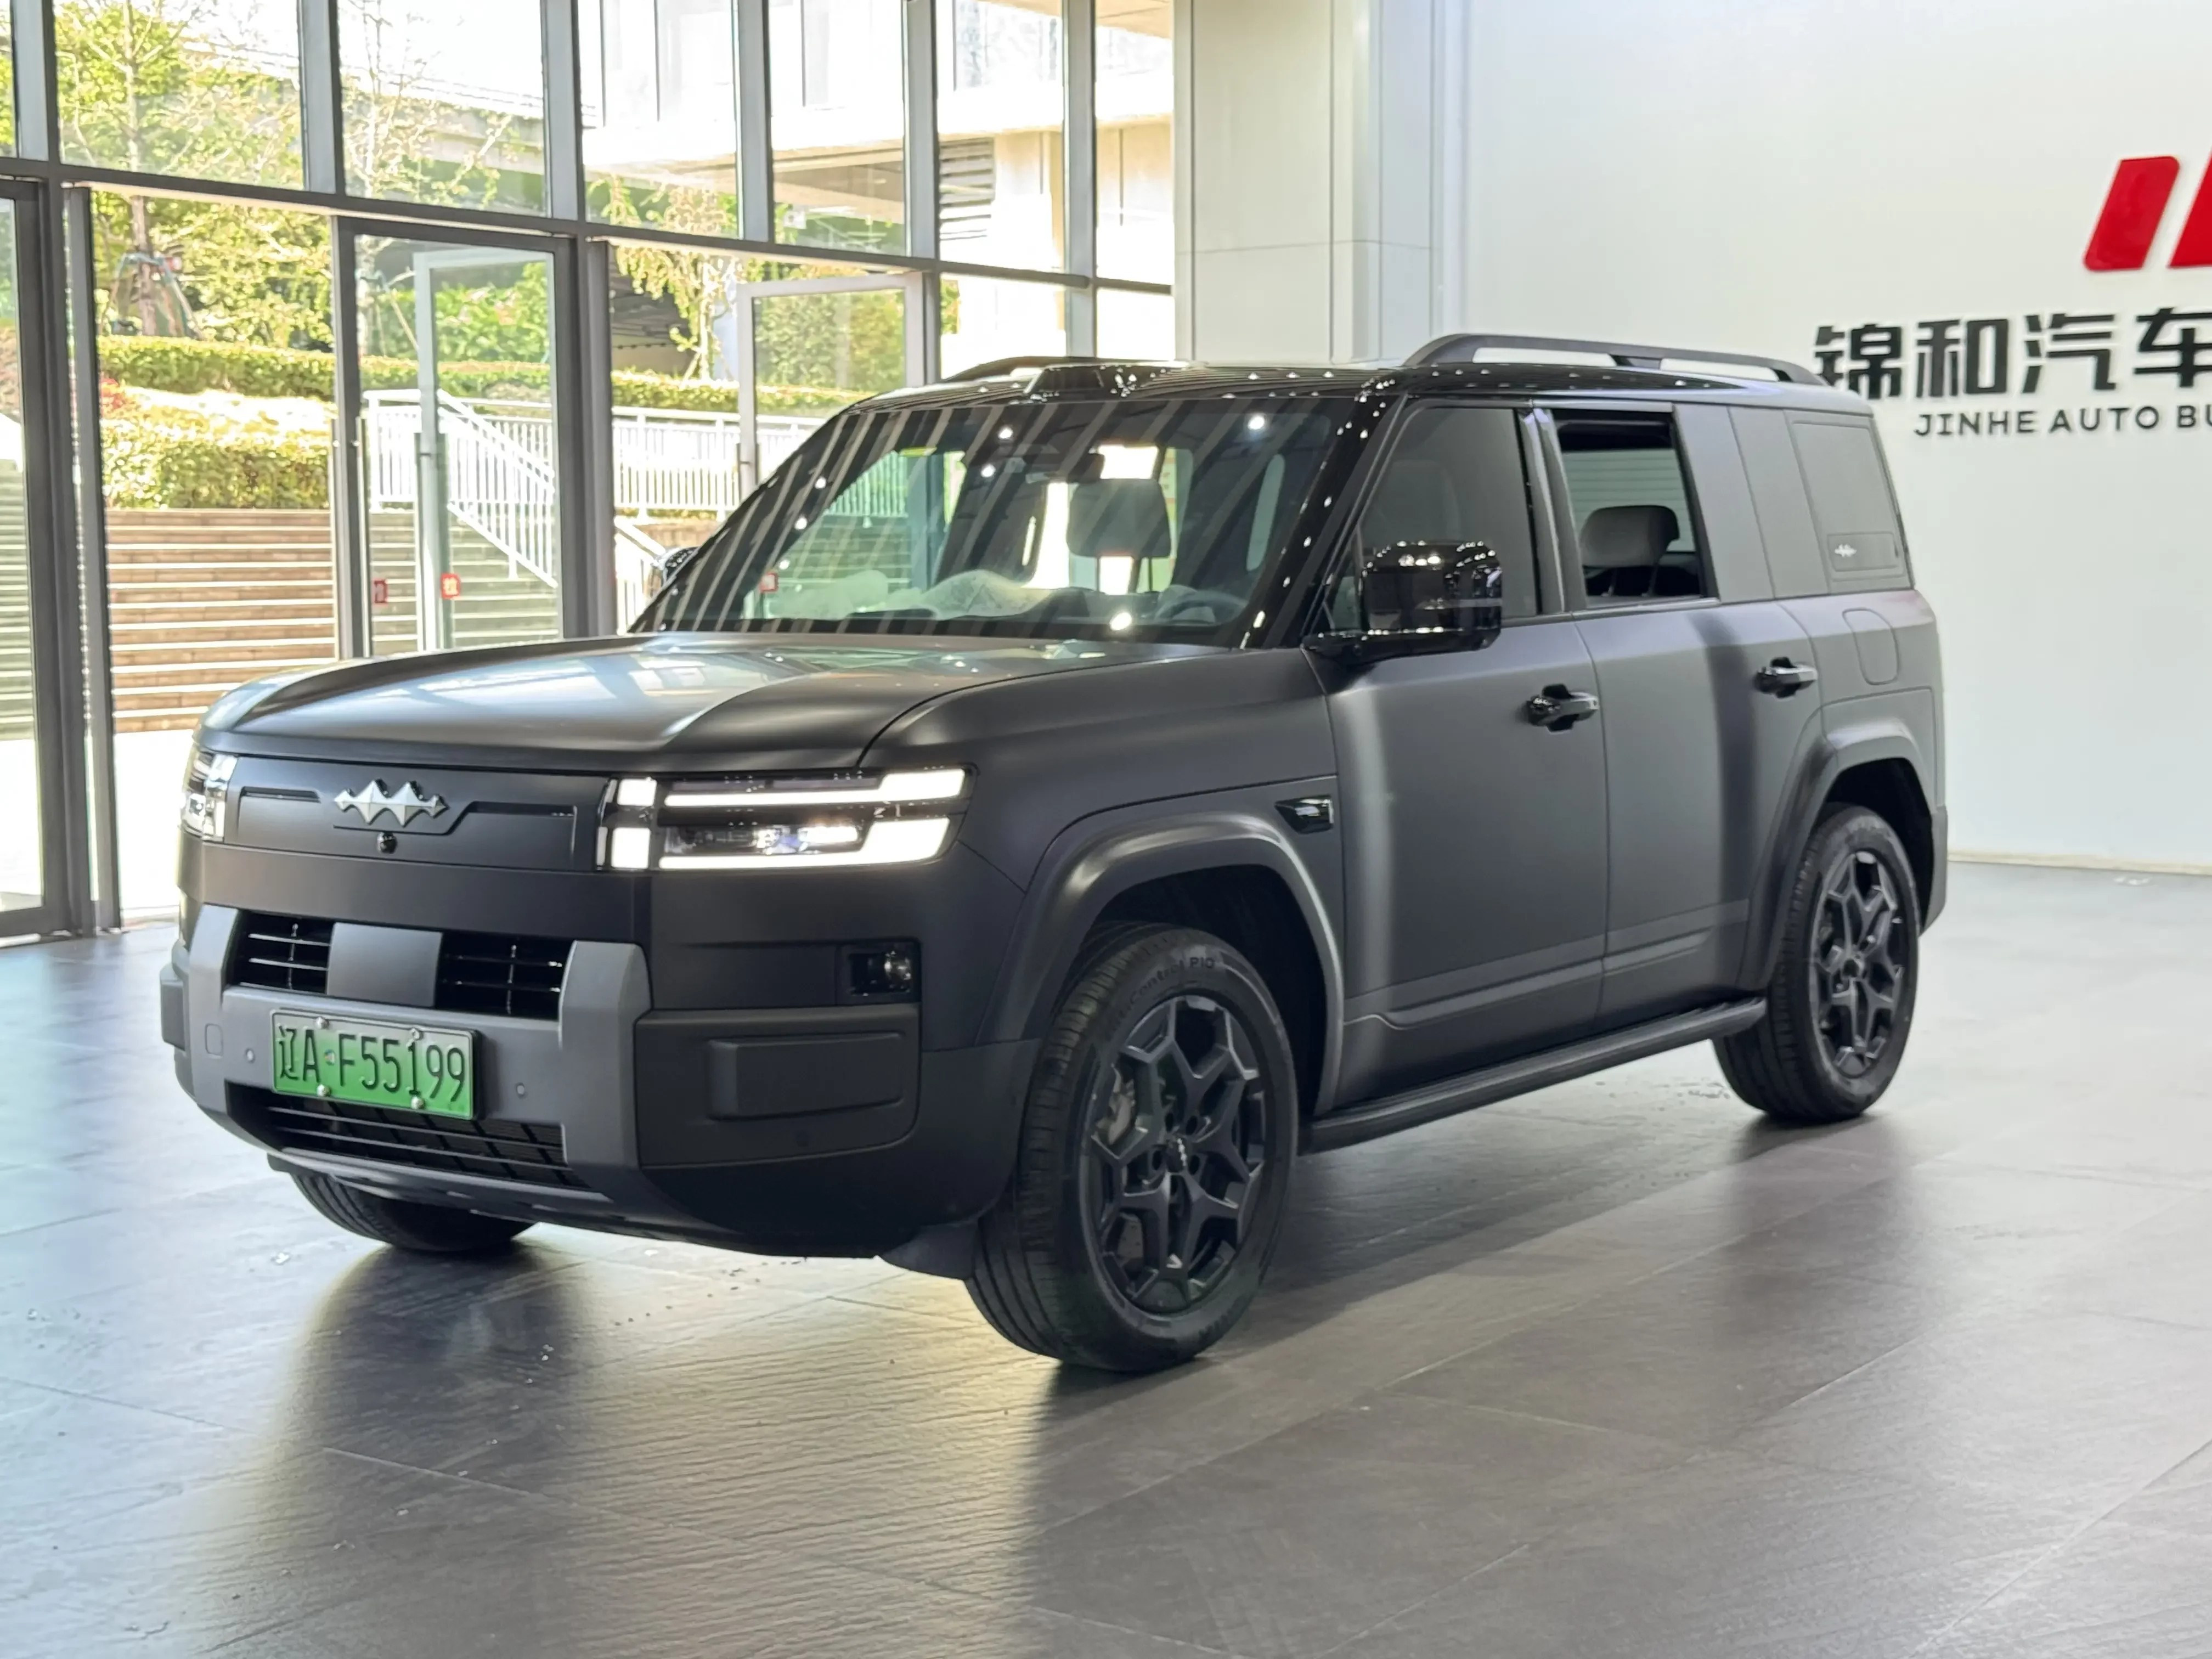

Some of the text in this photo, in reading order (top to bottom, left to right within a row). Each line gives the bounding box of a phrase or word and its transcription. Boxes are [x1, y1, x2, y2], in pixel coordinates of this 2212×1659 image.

[1814, 307, 2212, 399] 锦和汽车
[1914, 410, 2037, 436] JINHE
[2049, 405, 2159, 433] AUTO
